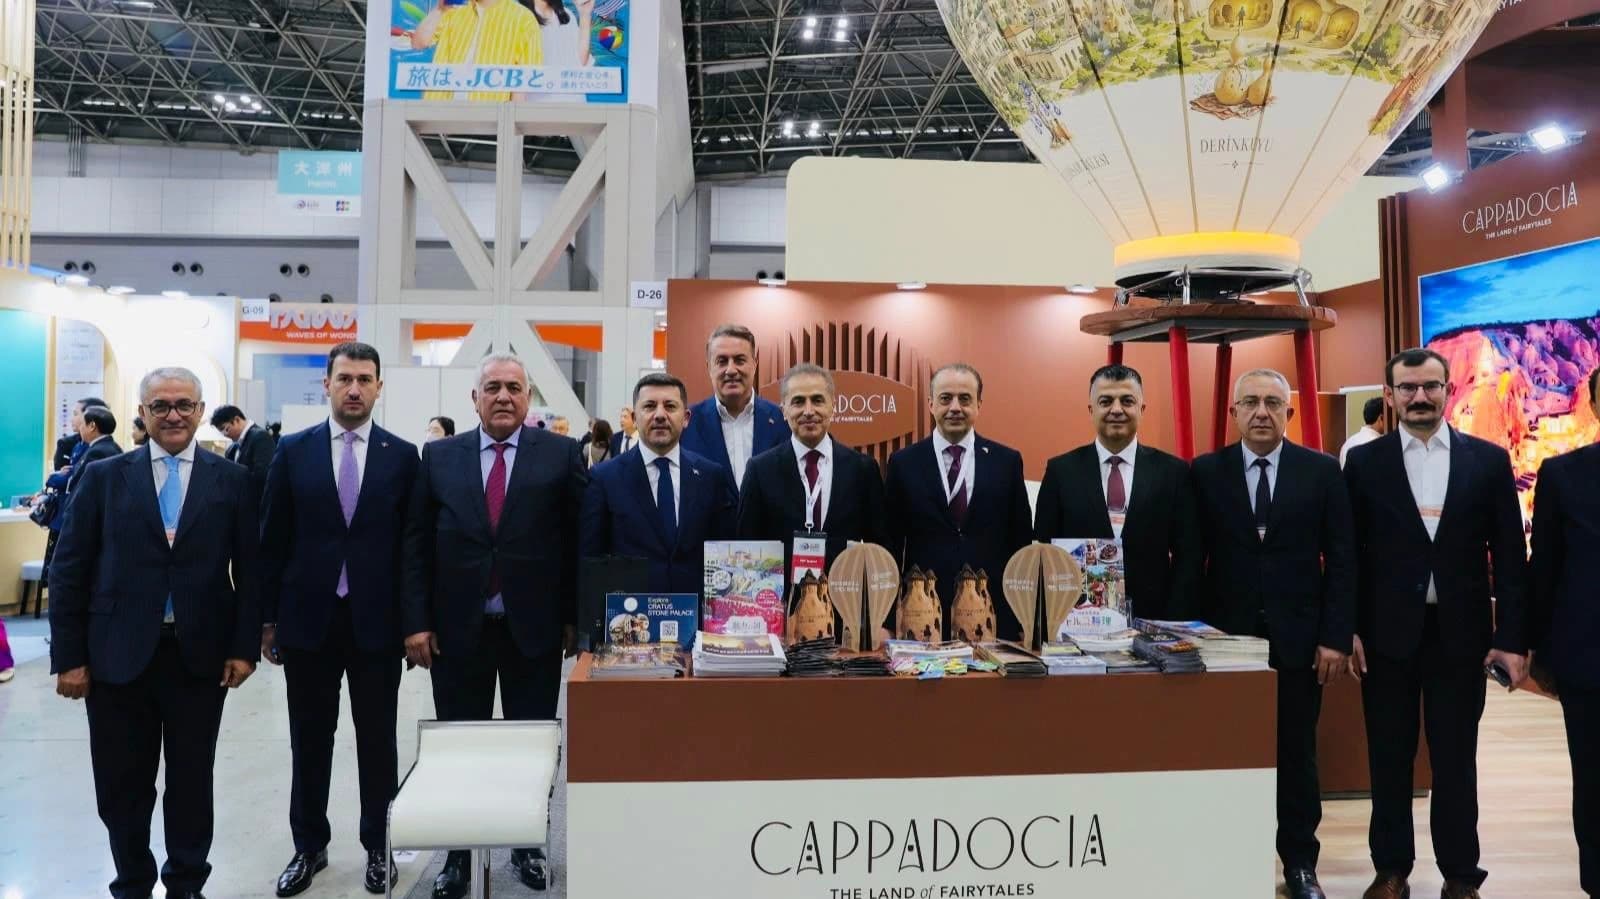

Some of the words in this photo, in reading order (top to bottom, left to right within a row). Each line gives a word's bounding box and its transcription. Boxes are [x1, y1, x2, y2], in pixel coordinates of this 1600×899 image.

[407, 66, 554, 89] 旅は、JCBと。
[1462, 181, 1578, 234] CAPPADOCIA
[1485, 232, 1496, 240] THE
[1497, 228, 1512, 237] LAND
[1518, 218, 1552, 232] FAIRYTALES
[637, 289, 662, 300] D-26
[242, 306, 264, 314] G-09
[286, 331, 315, 339] WAVES
[316, 331, 328, 339] OF
[329, 332, 357, 340] WOND
[750, 813, 1107, 876] CAPPADOCIA
[830, 887, 862, 899] THE
[869, 886, 915, 899] LAND
[920, 884, 936, 899] of
[939, 882, 1035, 899] FAIRYTALES
